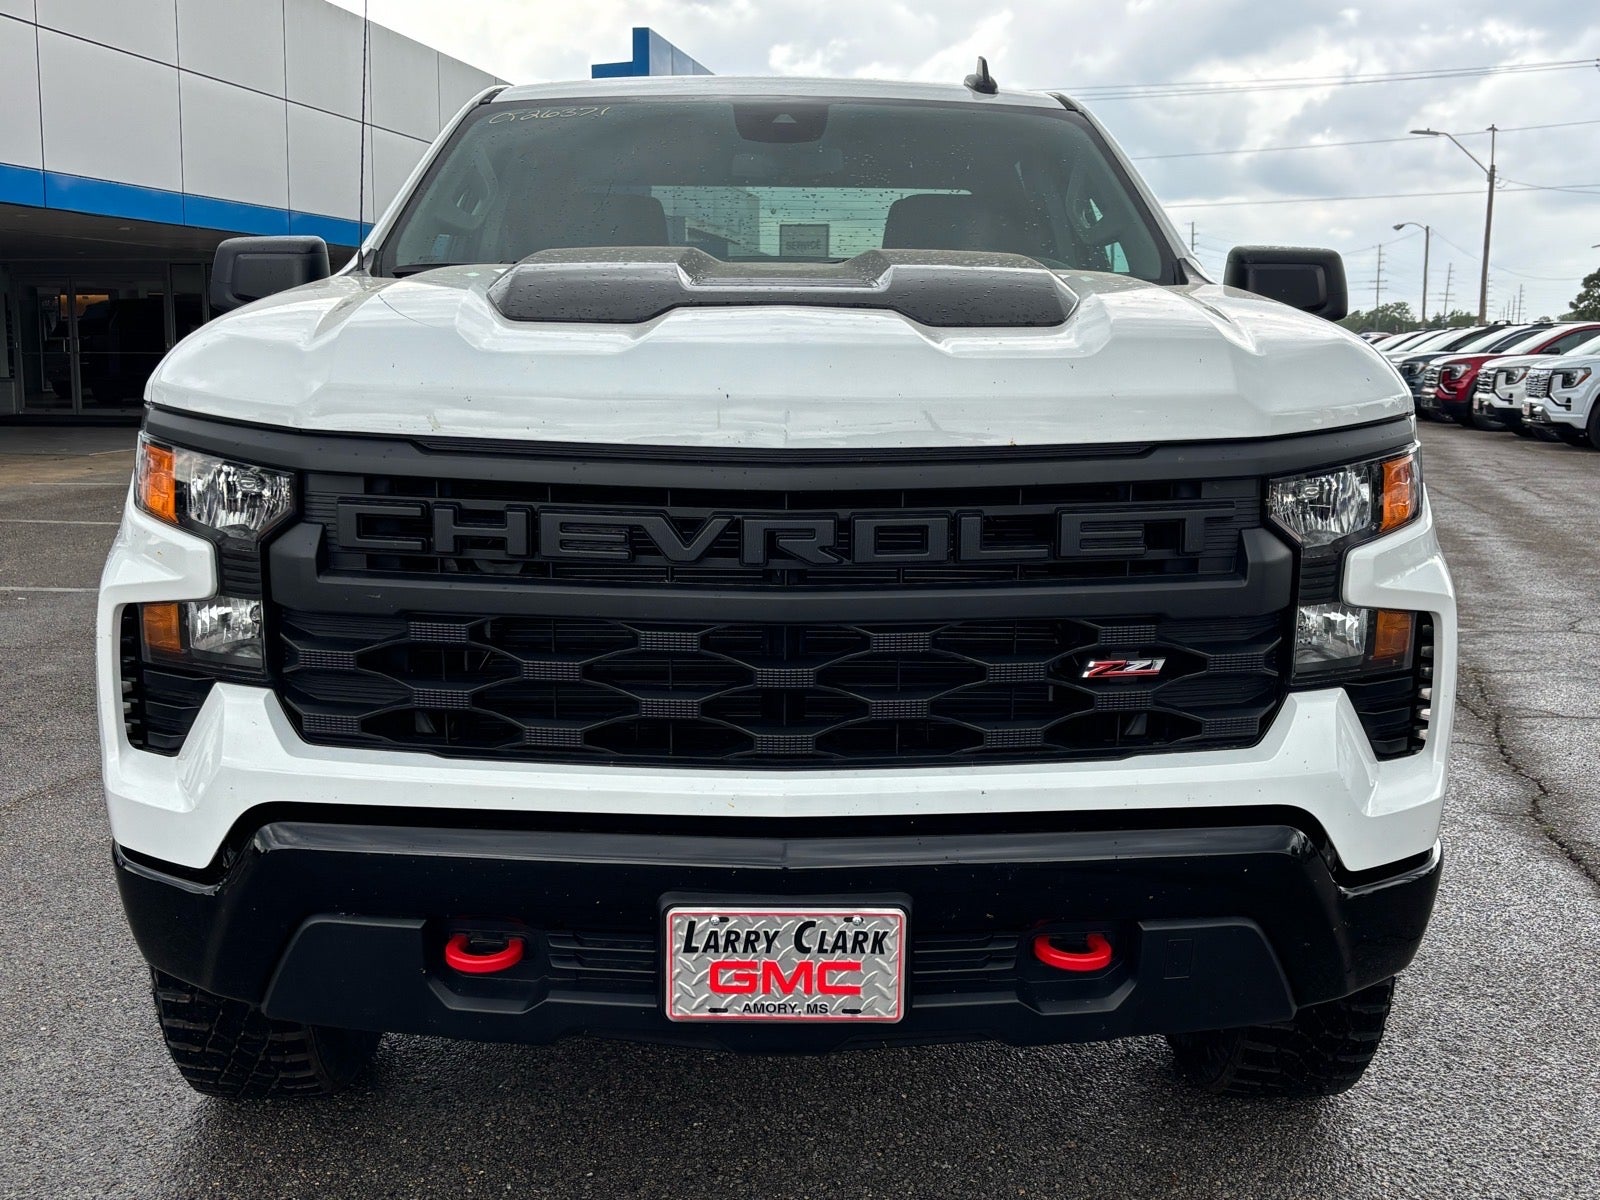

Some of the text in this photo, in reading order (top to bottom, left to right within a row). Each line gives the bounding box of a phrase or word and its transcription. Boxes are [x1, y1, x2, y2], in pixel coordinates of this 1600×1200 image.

[336, 498, 1236, 567] CHEVROLET
[1082, 659, 1165, 678] Z71
[682, 920, 889, 954] LARRY CLARK
[709, 961, 862, 996] GMC
[742, 1003, 829, 1014] AMORY, MS
